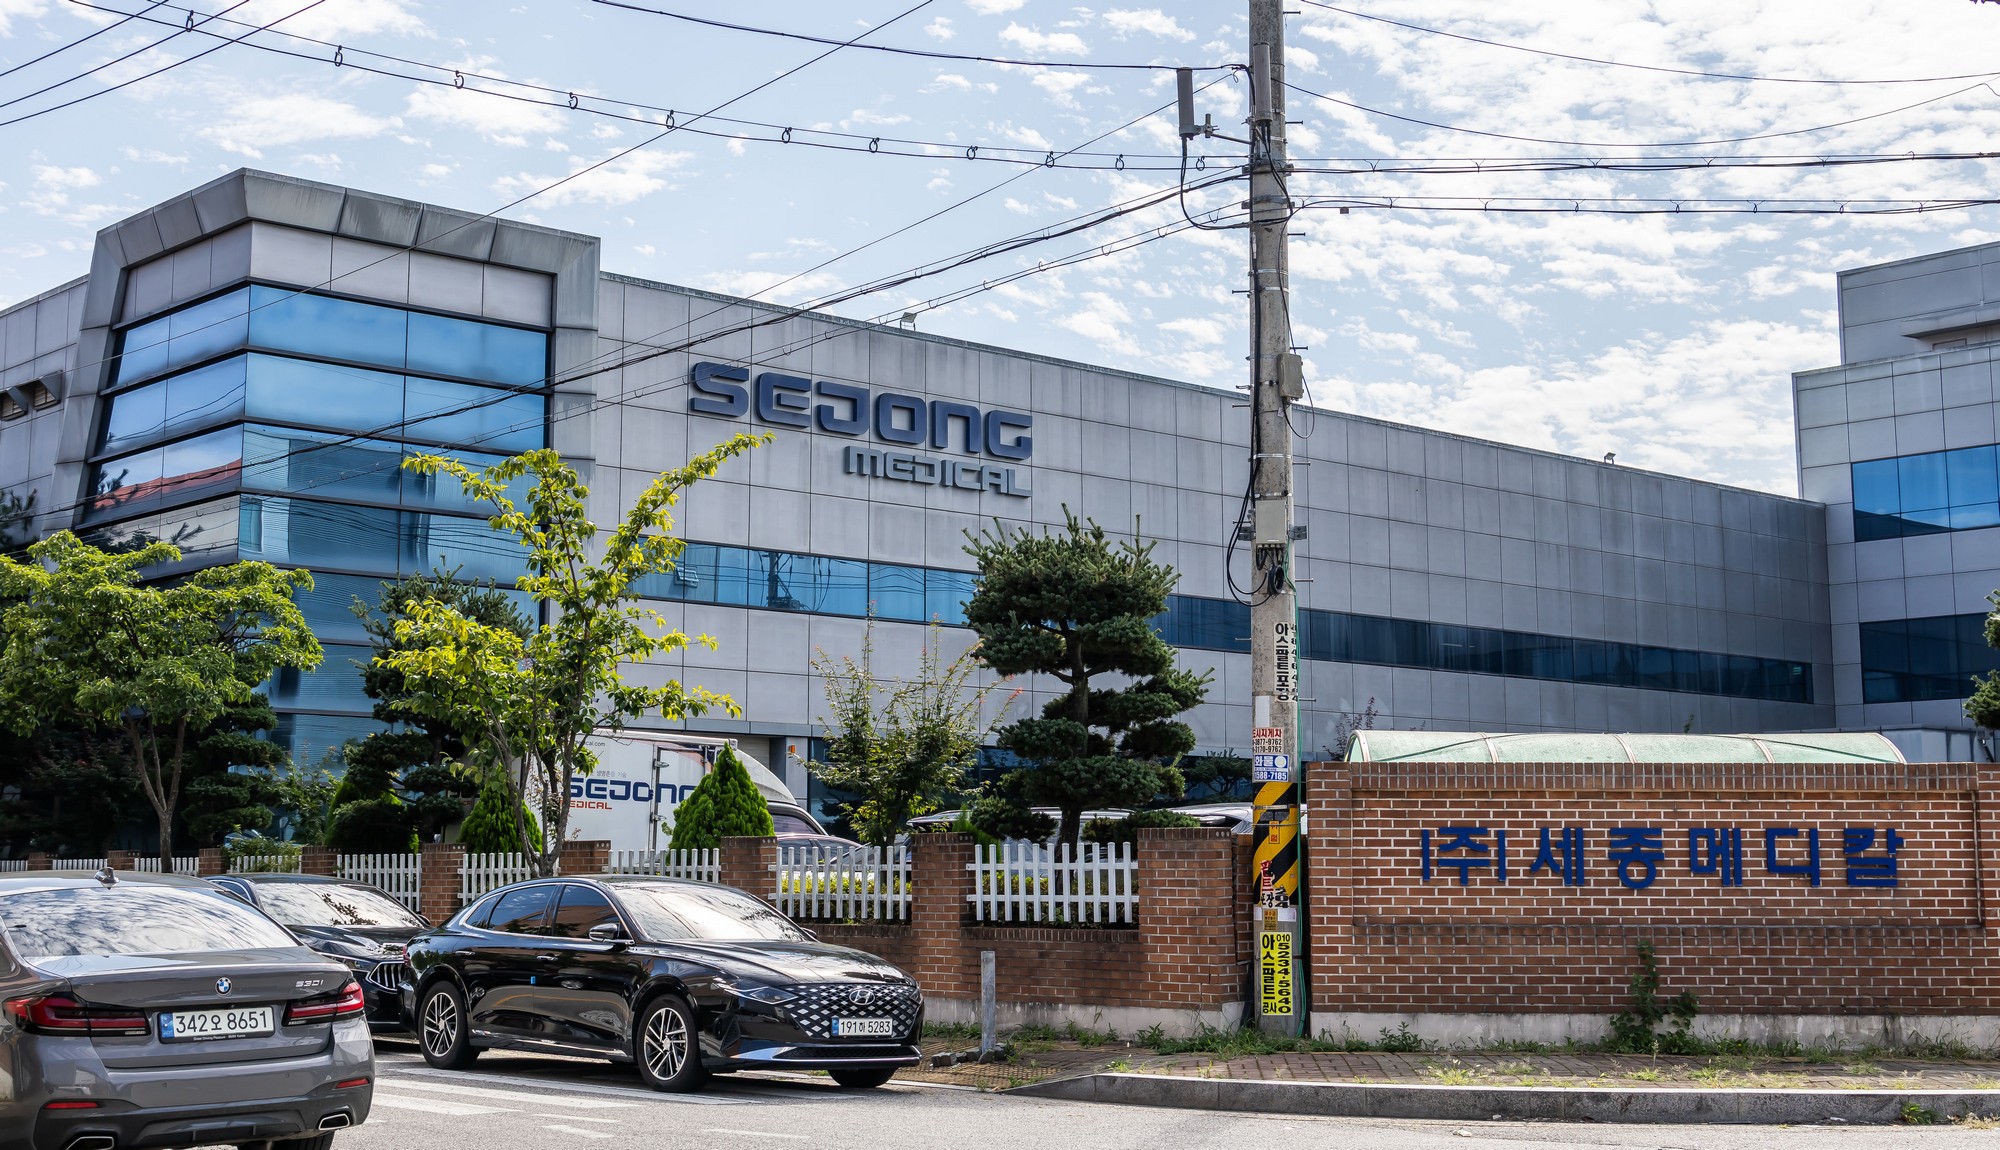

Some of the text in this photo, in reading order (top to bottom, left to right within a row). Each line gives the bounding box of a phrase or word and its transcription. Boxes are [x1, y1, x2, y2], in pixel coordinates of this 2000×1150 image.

[690, 361, 1033, 460] SEJONG
[845, 445, 1034, 498] MEDICAL
[569, 800, 613, 810] EDICAL
[1262, 934, 1276, 1000] 아스팔트
[1262, 1001, 1277, 1014] 공사
[176, 1011, 267, 1033] 342오 8651
[868, 1021, 890, 1033] 5283
